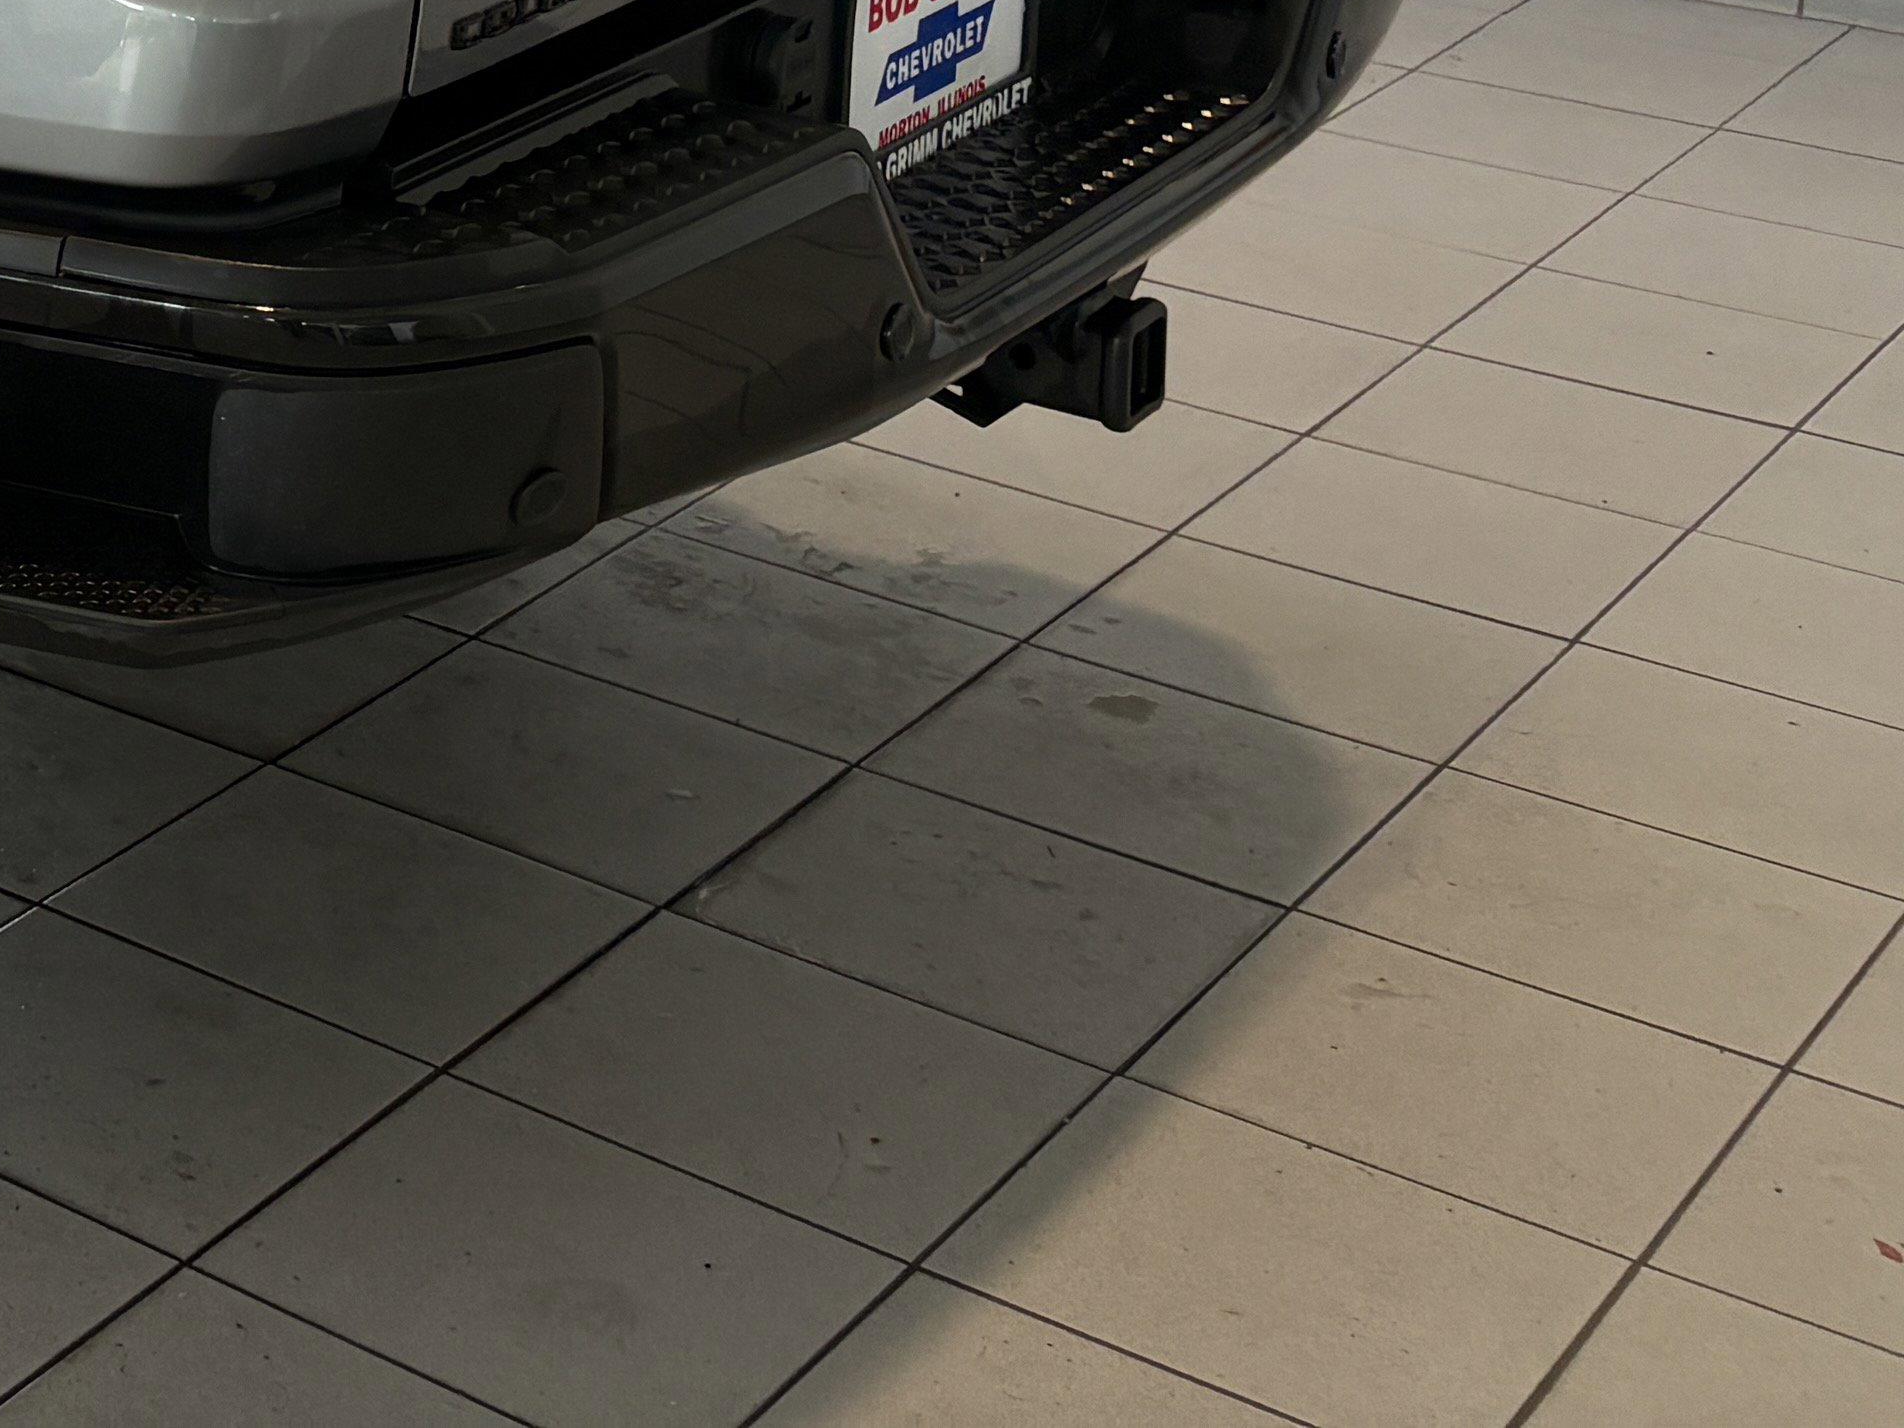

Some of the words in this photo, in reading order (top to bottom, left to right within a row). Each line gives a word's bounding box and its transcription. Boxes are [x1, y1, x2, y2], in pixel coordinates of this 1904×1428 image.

[886, 15, 984, 91] CHEVROLET
[886, 133, 938, 182] GRIMM
[942, 76, 1033, 151] CHEVROLET
[937, 75, 987, 120] ILLINOIS
